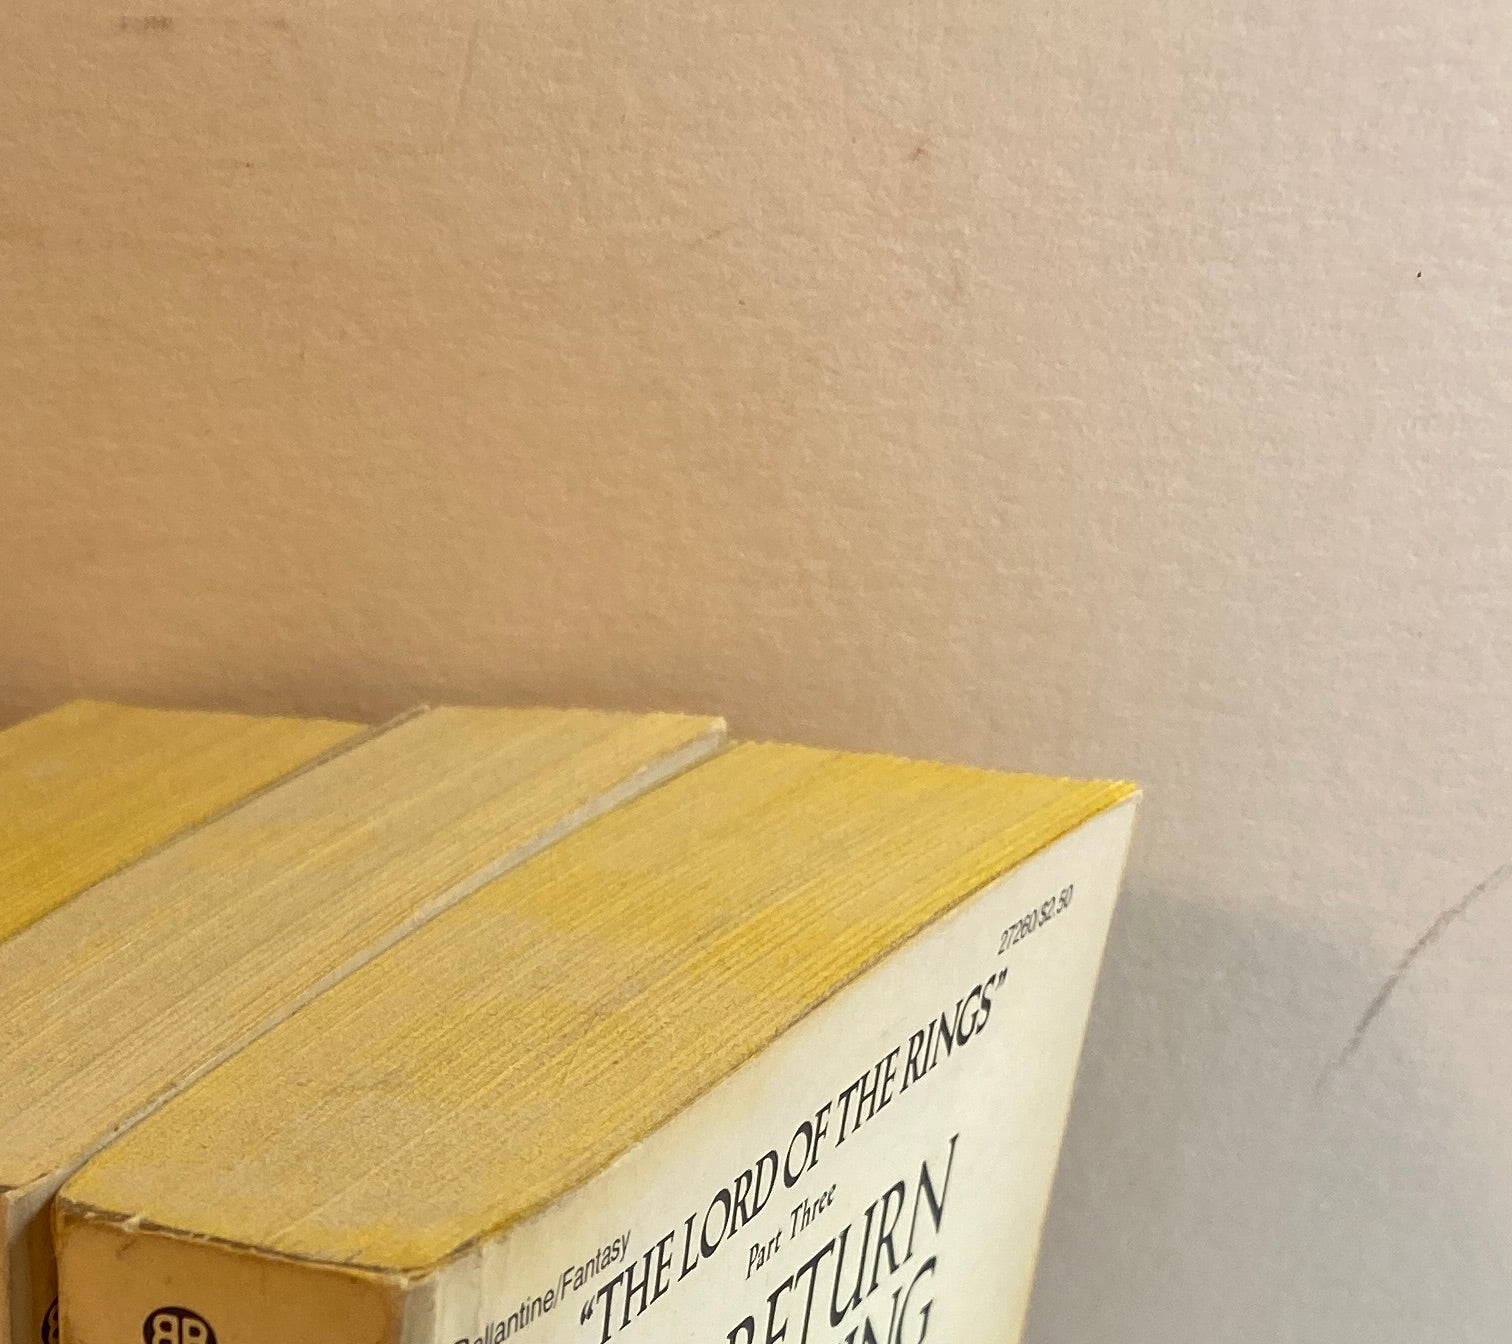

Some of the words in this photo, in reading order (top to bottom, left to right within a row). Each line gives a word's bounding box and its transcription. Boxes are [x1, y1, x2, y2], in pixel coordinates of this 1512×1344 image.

[678, 1150, 778, 1282] LORD
[782, 1102, 832, 1188] OF
[835, 1046, 901, 1149] THE
[746, 1231, 782, 1280] Part
[789, 1183, 837, 1242] Three
